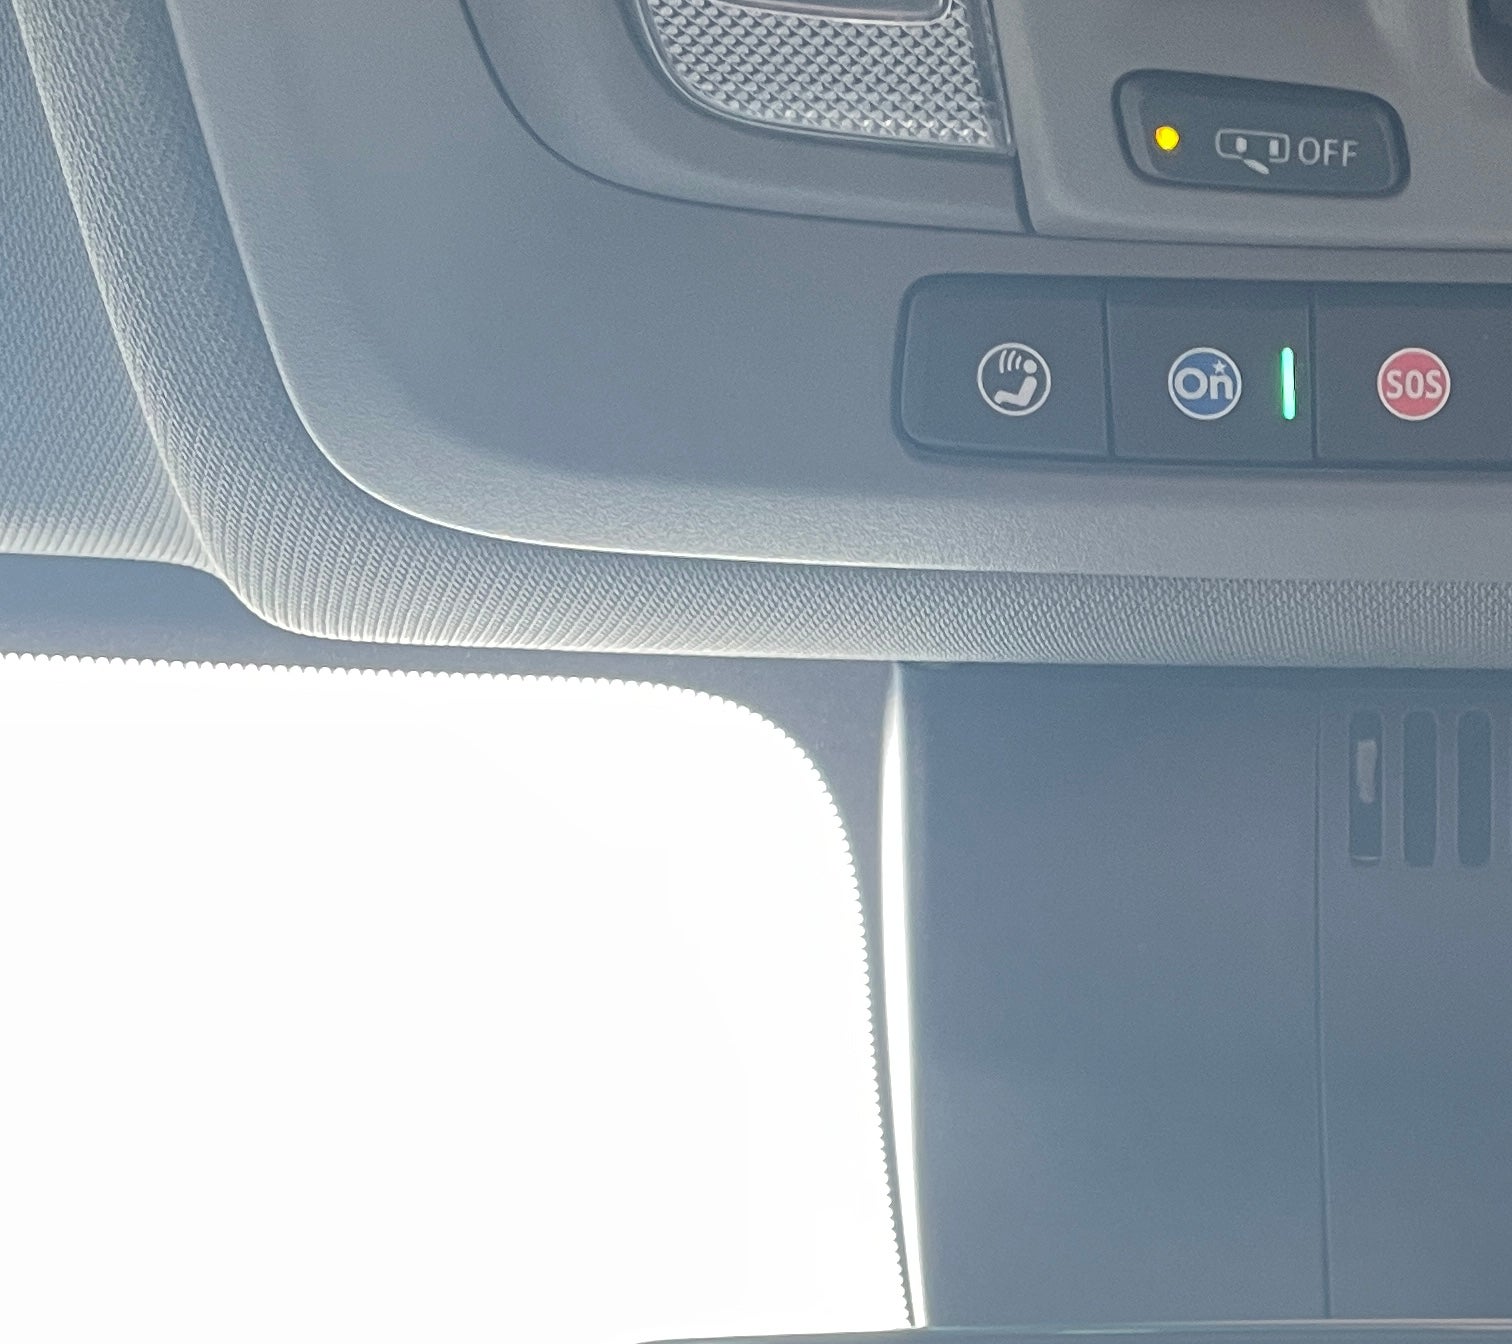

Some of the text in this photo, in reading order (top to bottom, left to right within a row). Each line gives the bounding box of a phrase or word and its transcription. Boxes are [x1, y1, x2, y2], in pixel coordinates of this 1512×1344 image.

[1297, 136, 1359, 167] OFF
[1172, 365, 1235, 402] On
[1384, 368, 1445, 401] SOS
